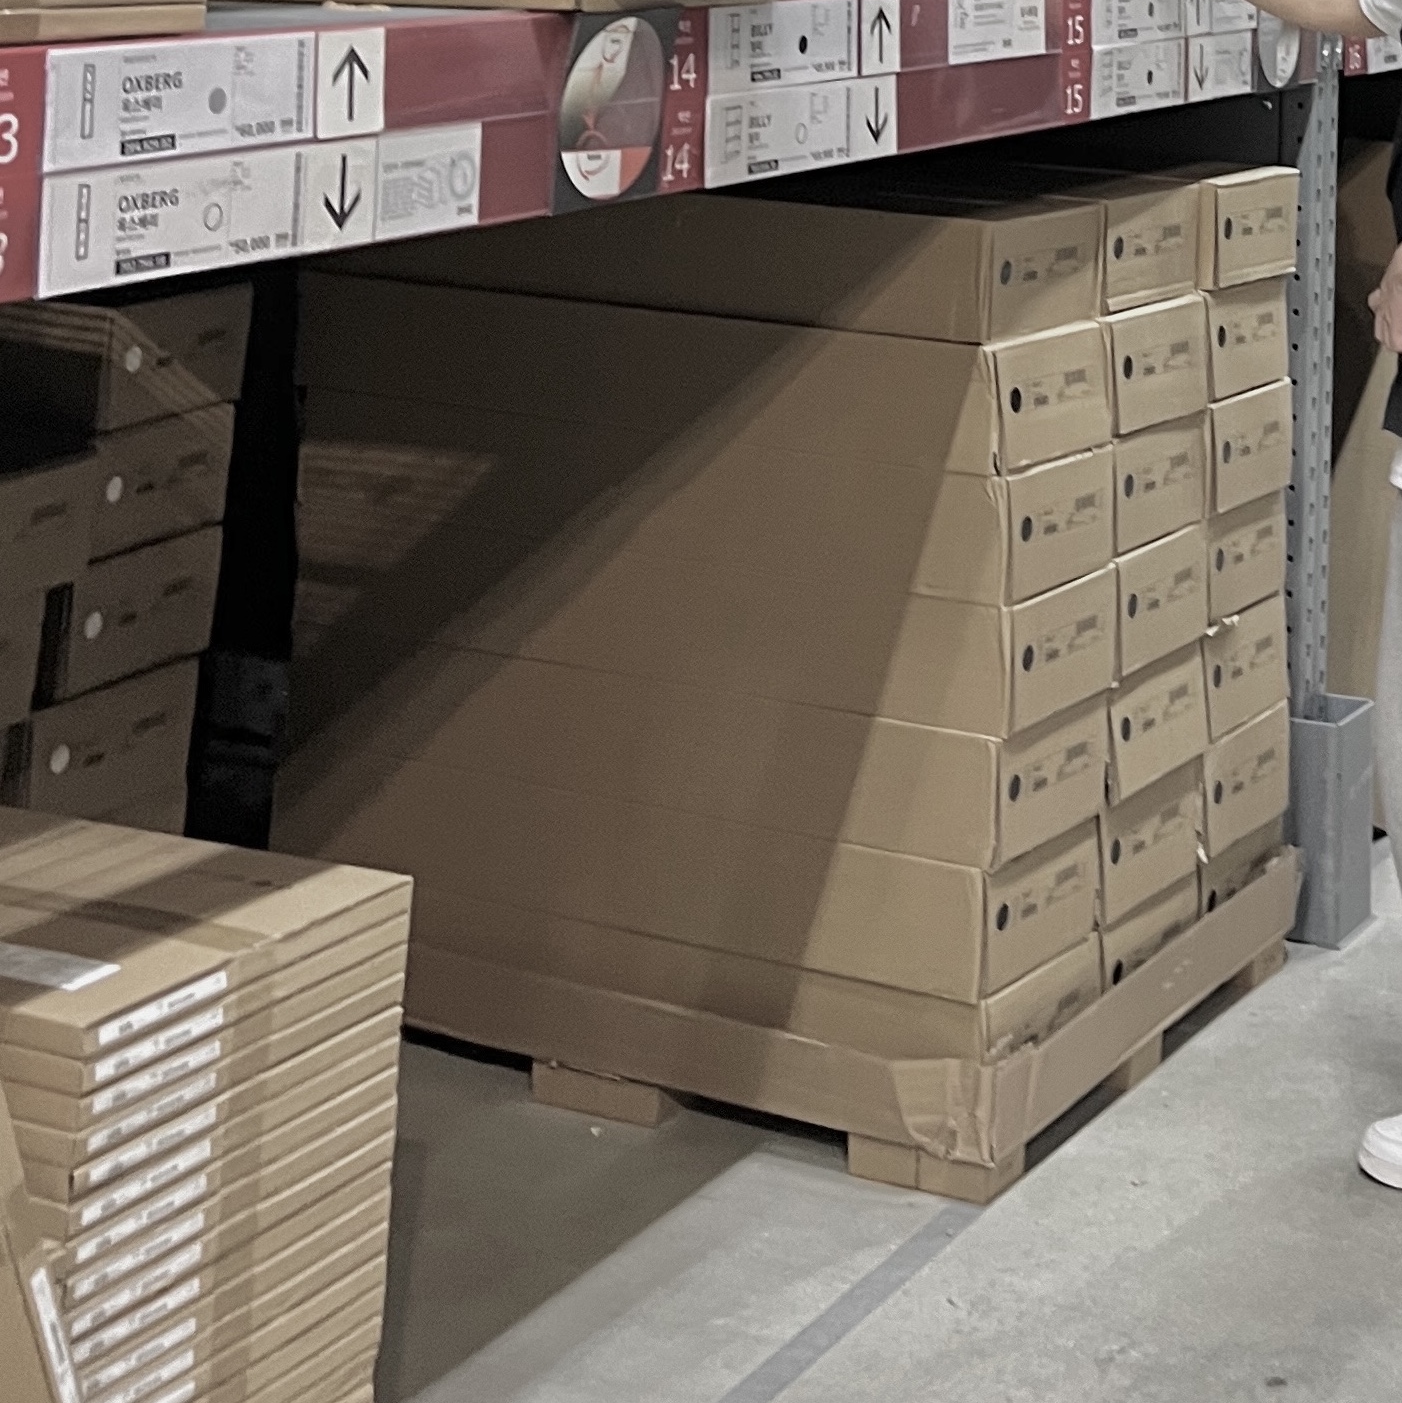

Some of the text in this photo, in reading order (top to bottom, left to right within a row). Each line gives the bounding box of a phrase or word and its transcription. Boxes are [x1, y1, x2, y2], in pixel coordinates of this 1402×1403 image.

[1067, 15, 1084, 45] 15
[121, 71, 184, 93] OXBERG
[669, 52, 697, 90] 14
[1064, 84, 1084, 114] 15
[662, 142, 692, 181] 14
[118, 188, 180, 214] OXBERG
